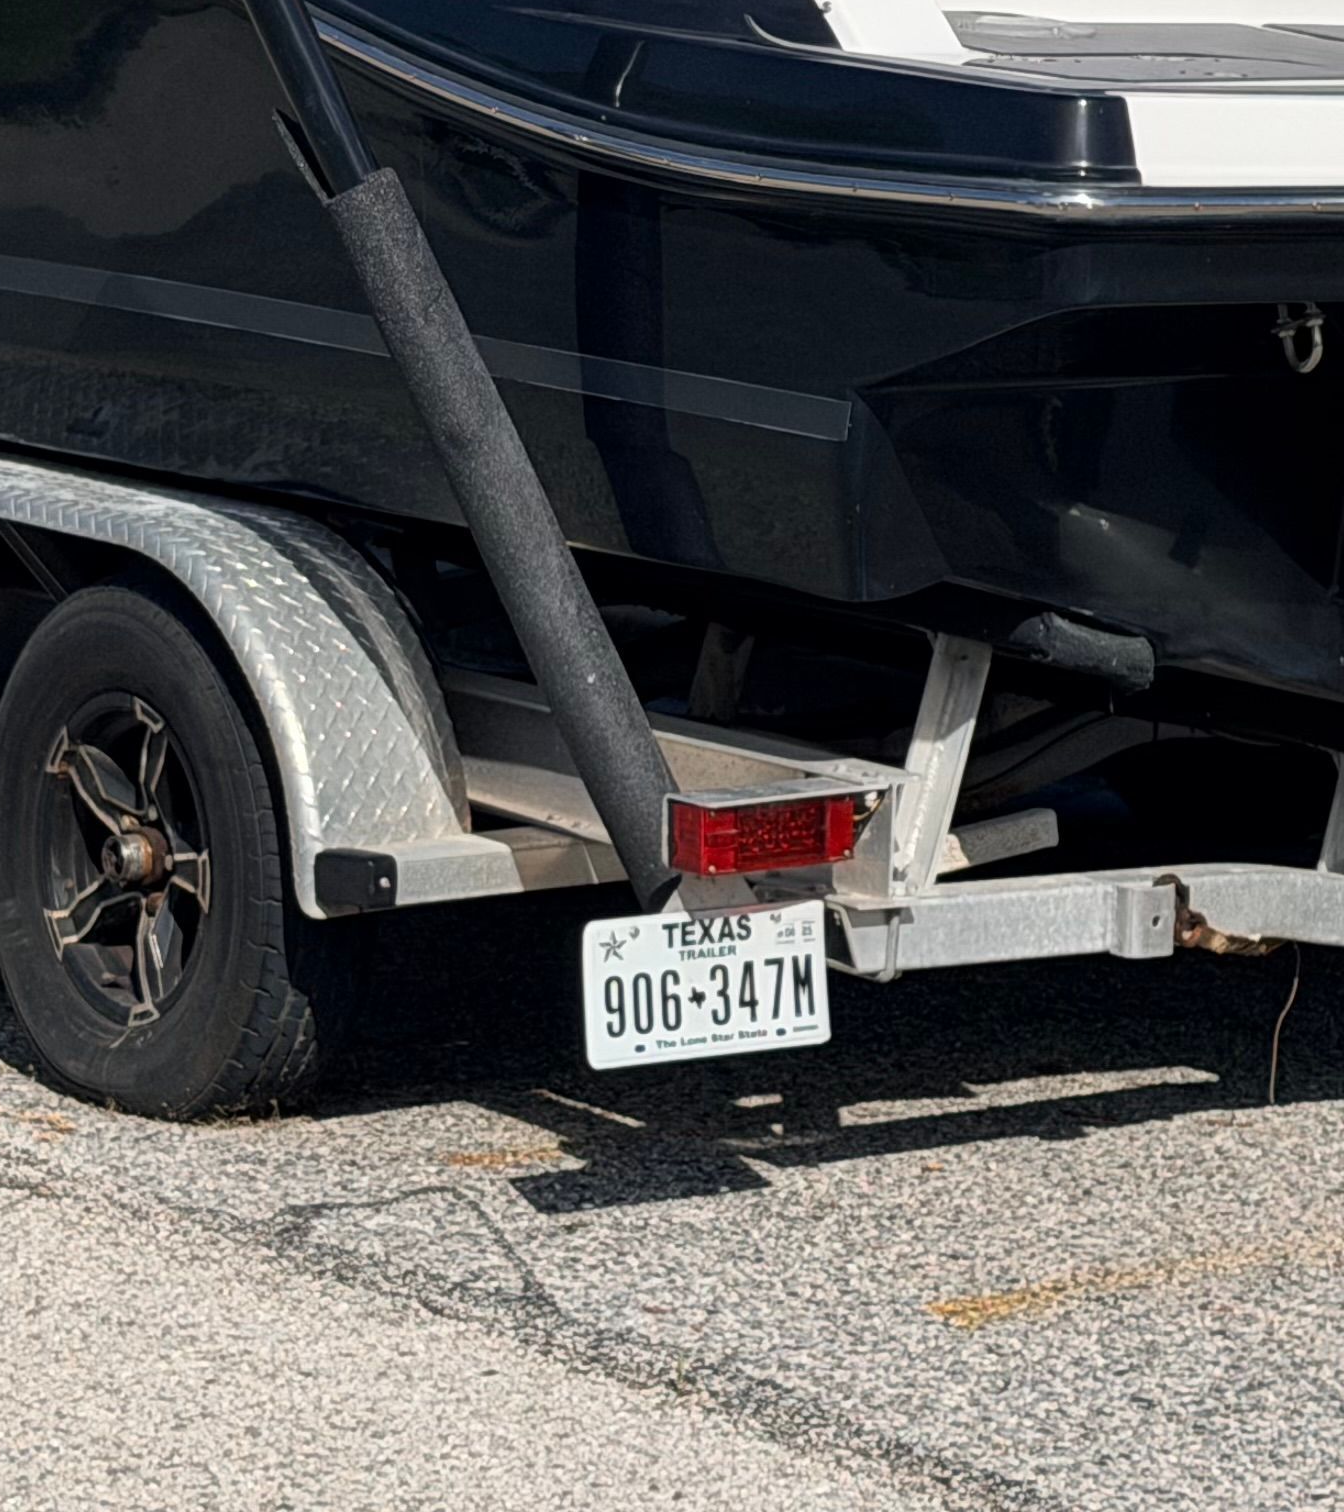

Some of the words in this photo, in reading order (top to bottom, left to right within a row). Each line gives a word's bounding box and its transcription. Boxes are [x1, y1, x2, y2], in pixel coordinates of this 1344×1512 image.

[662, 914, 752, 948] TEXAS
[679, 945, 737, 961] TRAILER
[604, 969, 682, 1038] 906
[709, 954, 816, 1026] 347M
[656, 1038, 677, 1049] The
[681, 1035, 707, 1047] Lone
